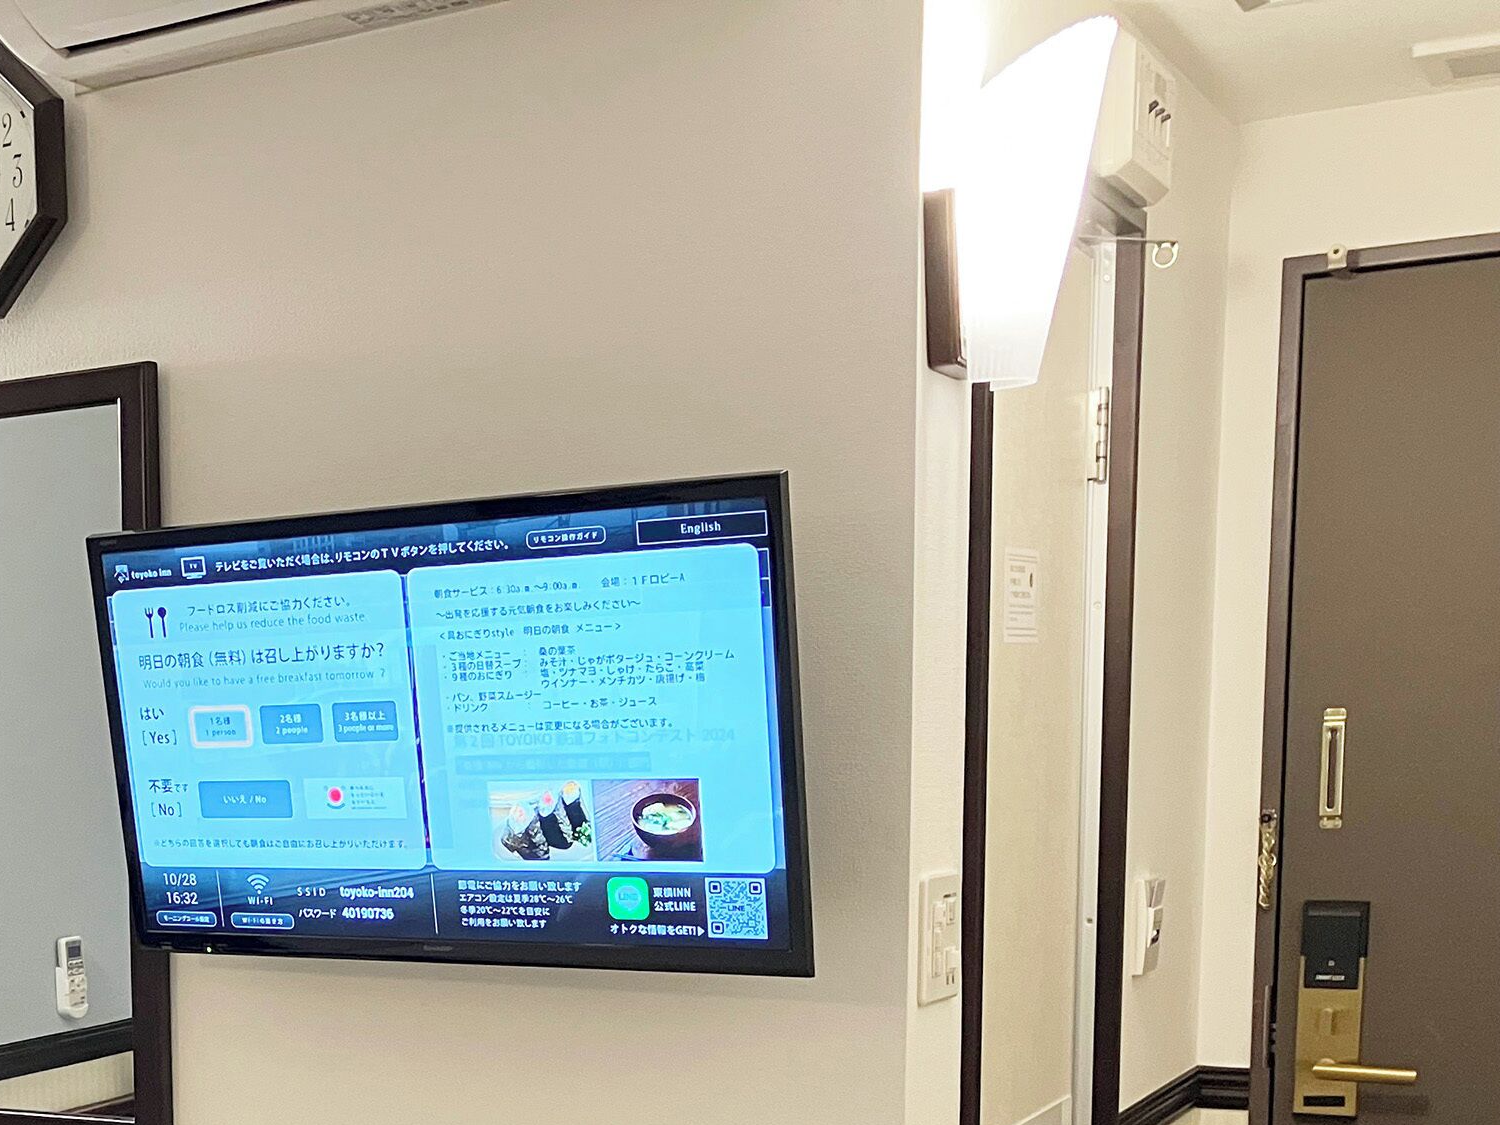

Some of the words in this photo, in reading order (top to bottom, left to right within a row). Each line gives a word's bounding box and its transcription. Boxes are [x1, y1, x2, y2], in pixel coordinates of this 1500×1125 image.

[1, 113, 12, 148] 2
[12, 153, 23, 188] 3
[5, 198, 15, 232] 4
[680, 521, 721, 535] English
[131, 571, 158, 580] toyoko
[159, 568, 172, 578] inn
[180, 622, 209, 632] Please
[213, 620, 234, 631] help
[251, 617, 284, 629] reduce
[287, 615, 305, 626] the
[307, 613, 331, 625] food
[334, 612, 365, 622] waste
[143, 678, 170, 689] Would
[175, 680, 190, 689] you
[193, 677, 208, 686] like
[212, 677, 220, 685] to
[224, 676, 245, 685] have
[257, 674, 275, 683] free
[278, 671, 321, 683] breakfast
[326, 671, 374, 680] tomorrow
[140, 706, 164, 720] はい
[212, 728, 236, 737] person
[282, 726, 308, 736] people
[148, 778, 188, 793] 不要です
[163, 873, 197, 887] 10/28
[165, 891, 199, 905] 16:32
[340, 886, 414, 900] toyoko-inn204
[299, 907, 337, 919] パスワード
[341, 906, 395, 920] 40190736
[654, 902, 696, 912] 公式LINE
